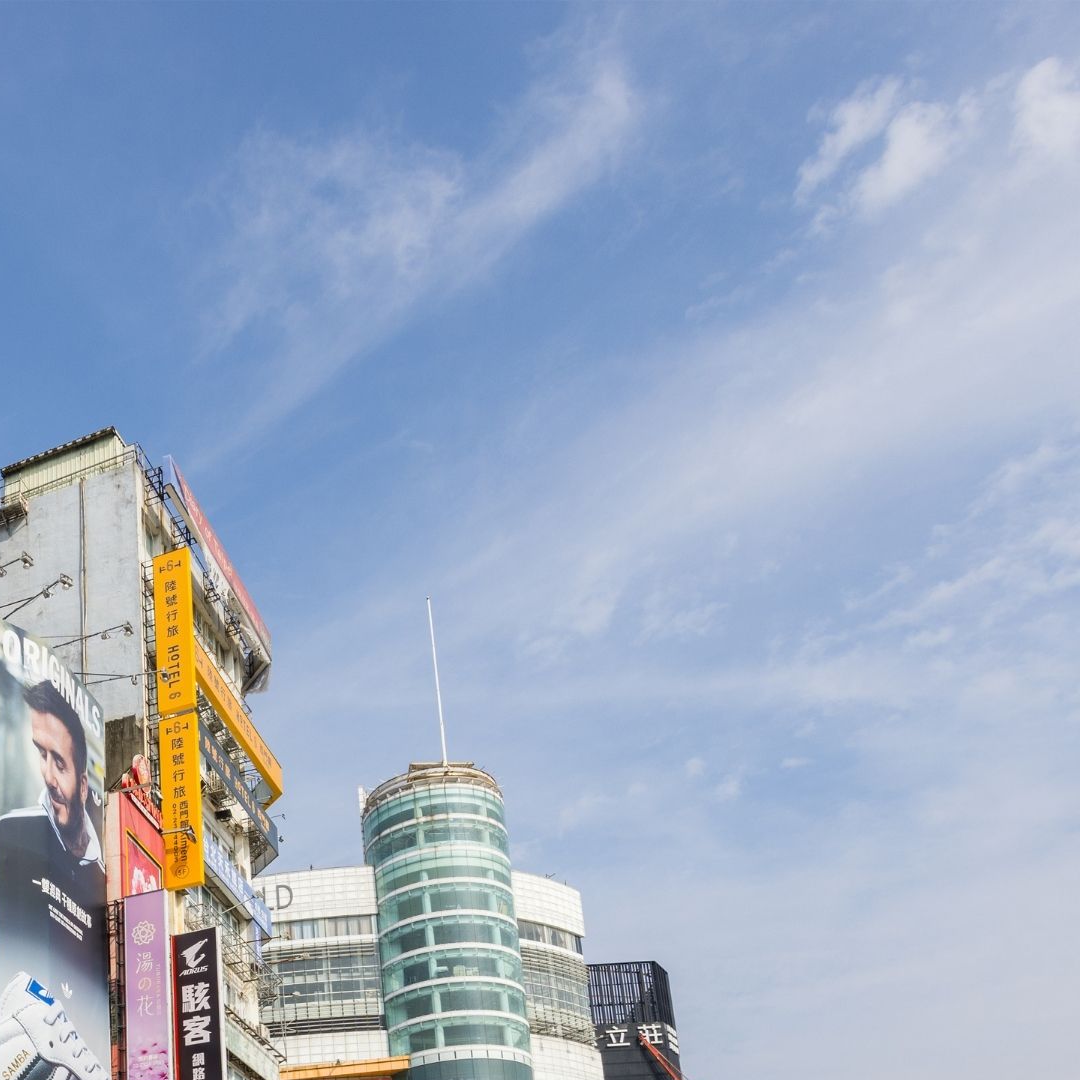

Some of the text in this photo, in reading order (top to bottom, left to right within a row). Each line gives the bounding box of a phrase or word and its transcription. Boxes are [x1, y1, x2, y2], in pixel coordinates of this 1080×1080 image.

[165, 579, 179, 638] 陸號行旅
[2, 629, 101, 737] ORIGINALS
[171, 738, 187, 799] 陸號行旅
[136, 952, 153, 1016] 湯の花
[179, 966, 208, 977] AORUS
[182, 982, 211, 1046] 駭客
